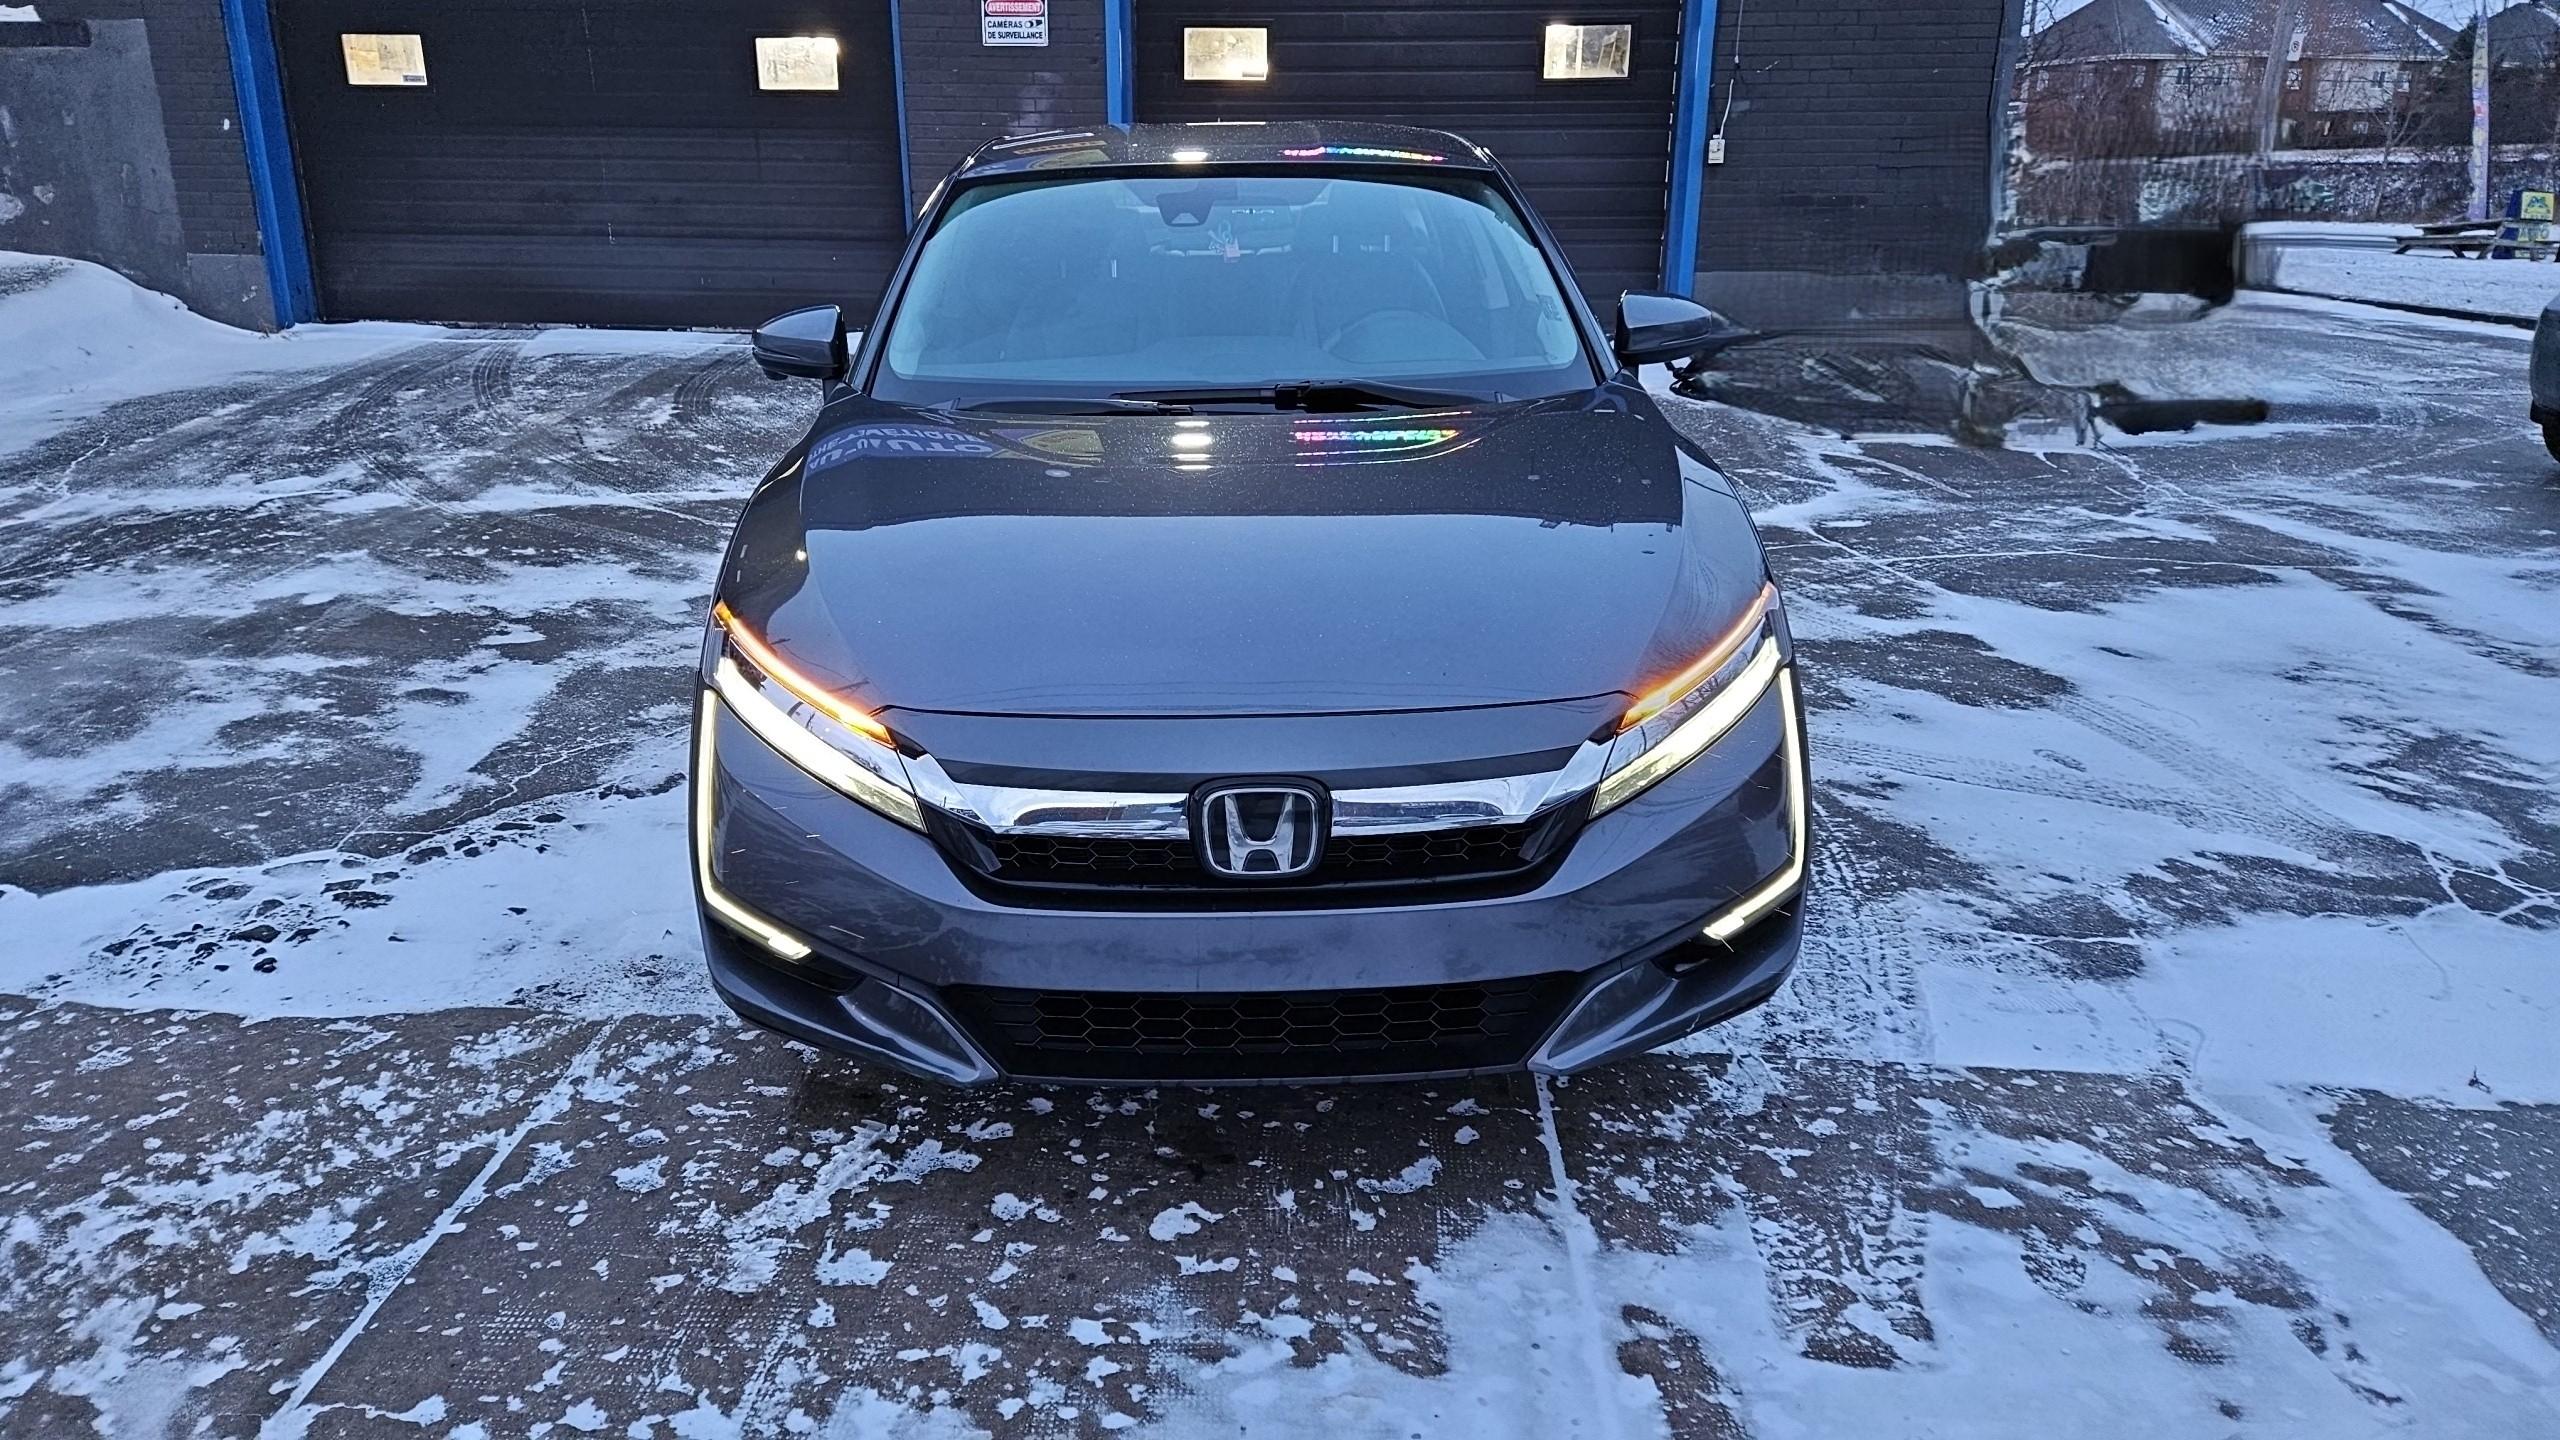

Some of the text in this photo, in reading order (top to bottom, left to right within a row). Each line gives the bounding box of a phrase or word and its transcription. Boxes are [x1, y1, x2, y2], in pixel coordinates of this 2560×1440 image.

[987, 2, 1041, 12] AVERTISSEMENT
[987, 31, 1043, 39] DE SURVEILLANCE
